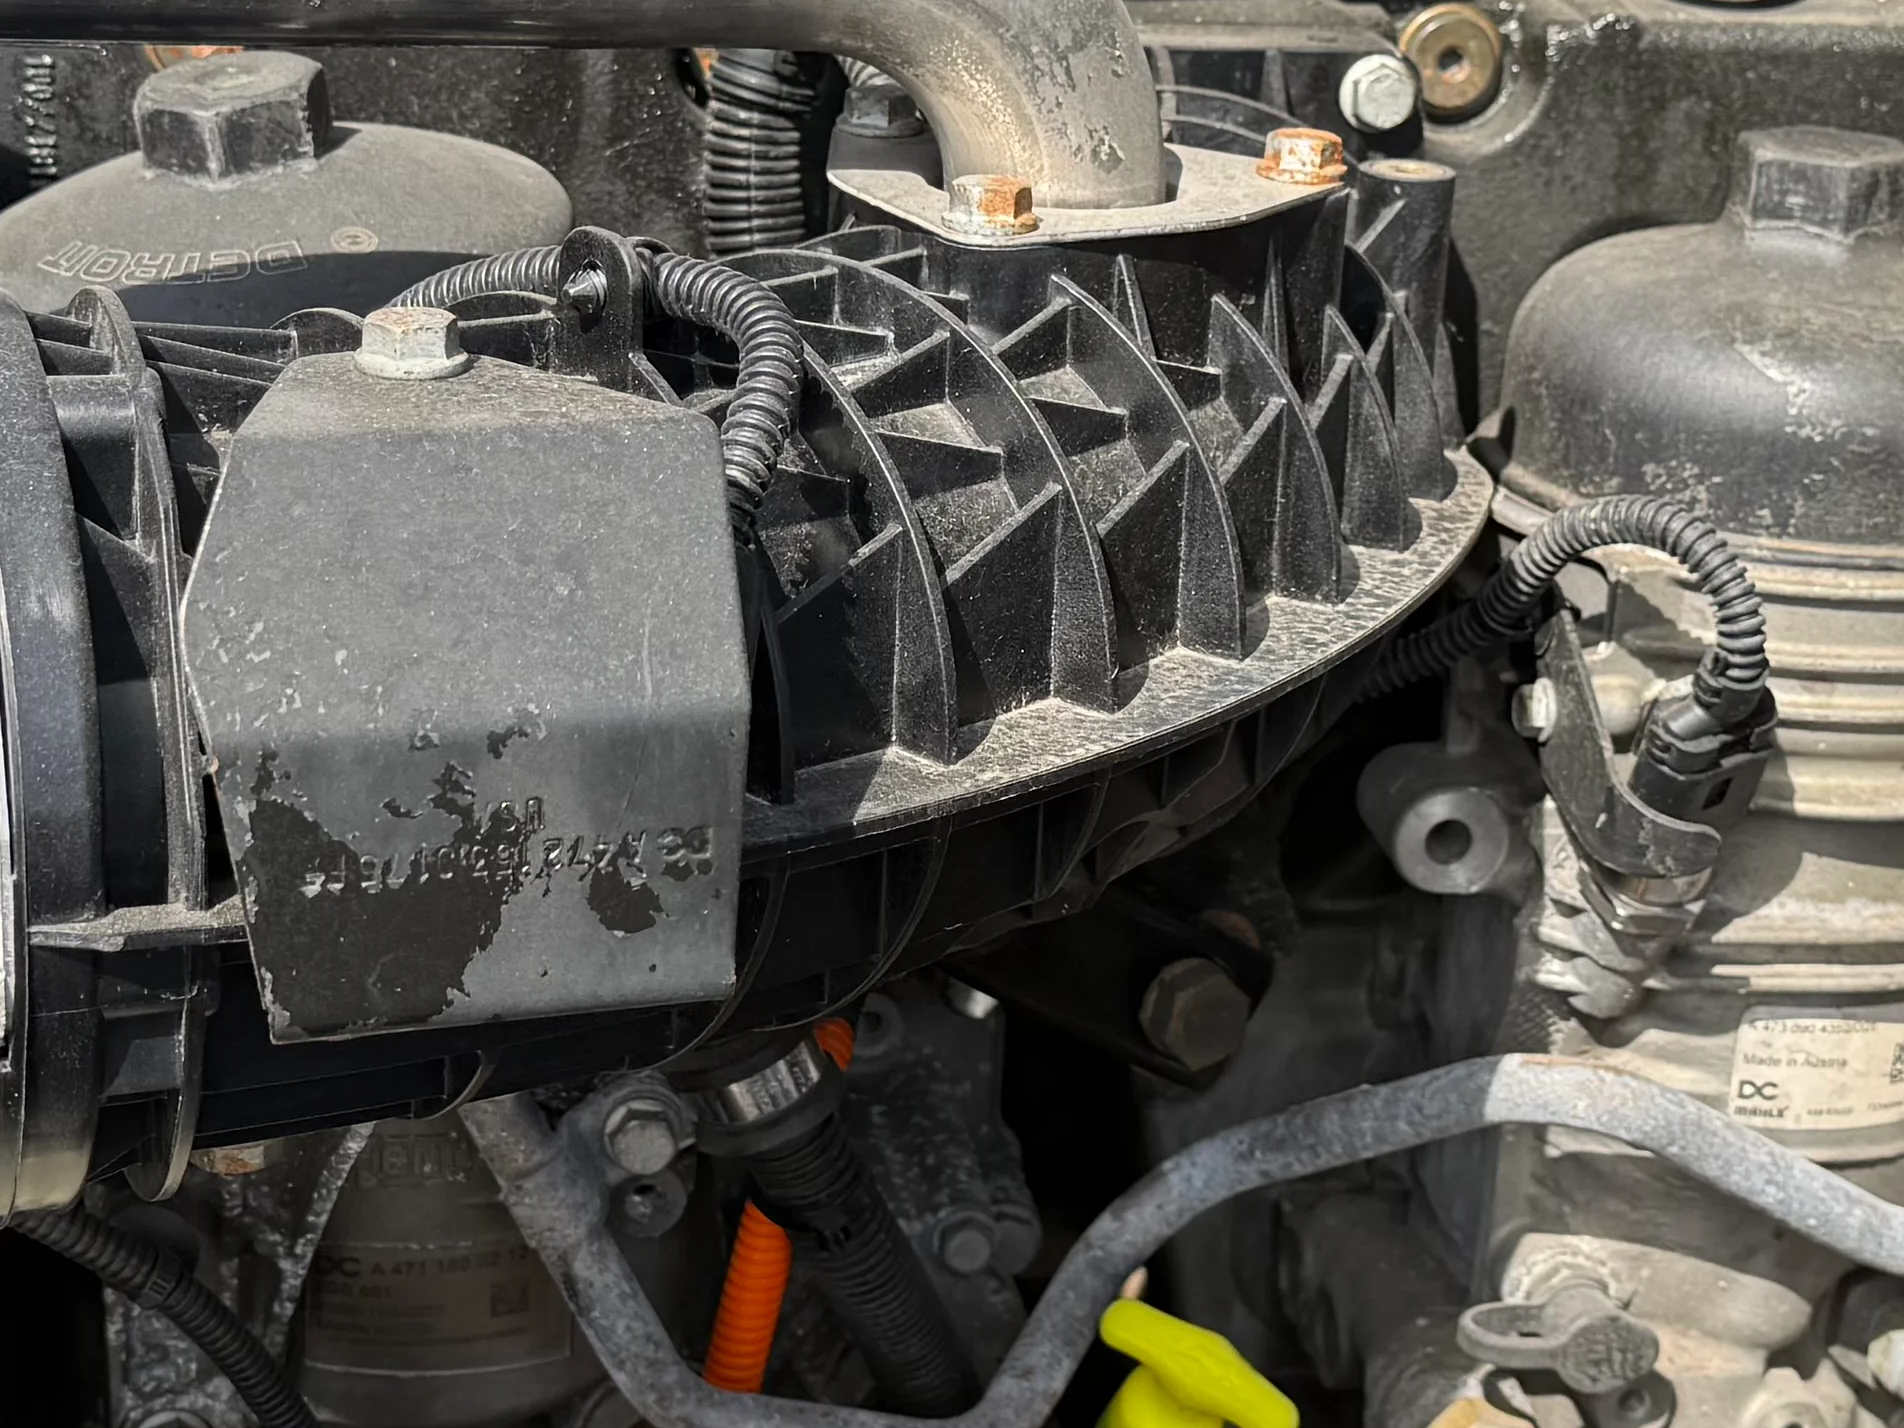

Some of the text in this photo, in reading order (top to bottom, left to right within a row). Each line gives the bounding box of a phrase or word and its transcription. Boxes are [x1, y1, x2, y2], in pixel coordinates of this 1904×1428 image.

[37, 239, 309, 286] DETROIT
[1743, 1054, 1848, 1069] Made in Austria
[1737, 1079, 1778, 1101] DC
